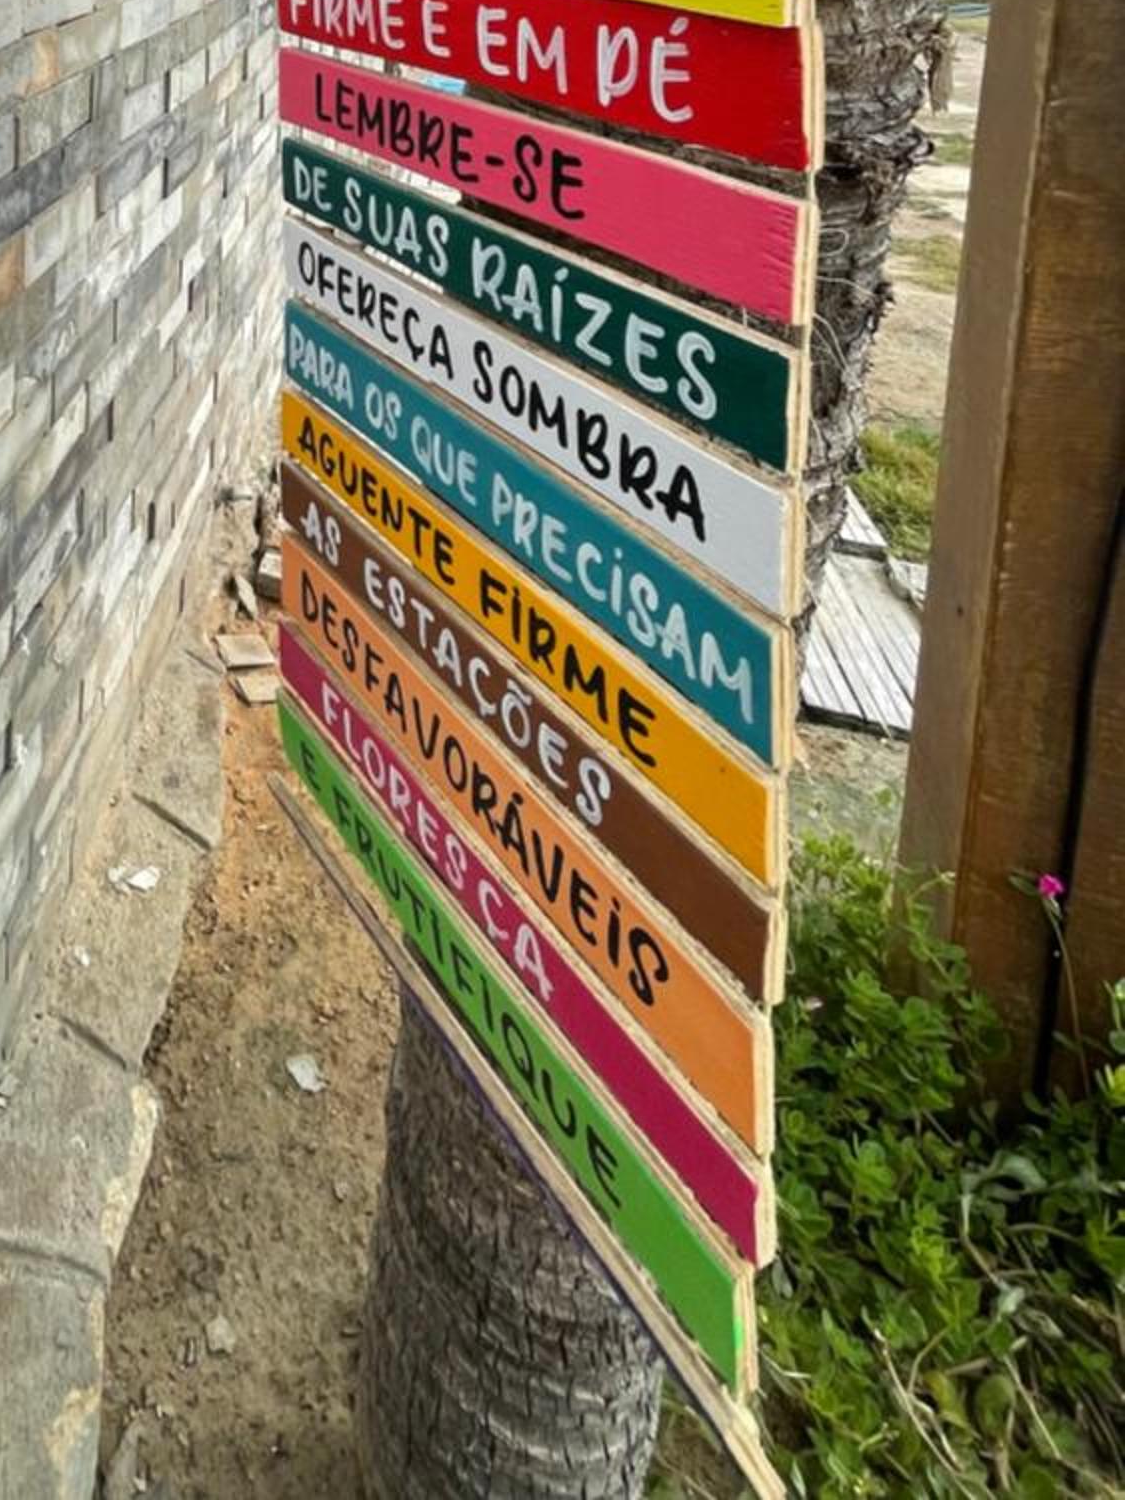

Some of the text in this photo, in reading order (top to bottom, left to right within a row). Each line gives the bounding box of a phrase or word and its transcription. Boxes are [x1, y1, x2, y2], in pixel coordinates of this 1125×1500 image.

[316, 74, 585, 221] LEMBRE-SE
[421, 0, 450, 58] E
[477, 5, 568, 95] EM
[597, 17, 694, 123] PÉ
[293, 157, 718, 420] DE SUAS RAÍZES
[298, 242, 706, 543] OFEREÇA SOMBRA
[289, 323, 353, 409] PARA
[365, 383, 402, 441] OS
[411, 415, 476, 507] QUE
[298, 416, 455, 586] AGUENTE
[303, 502, 611, 827] AS ESTAÇÕES
[301, 741, 622, 1207] E FRUTIFIQUE
